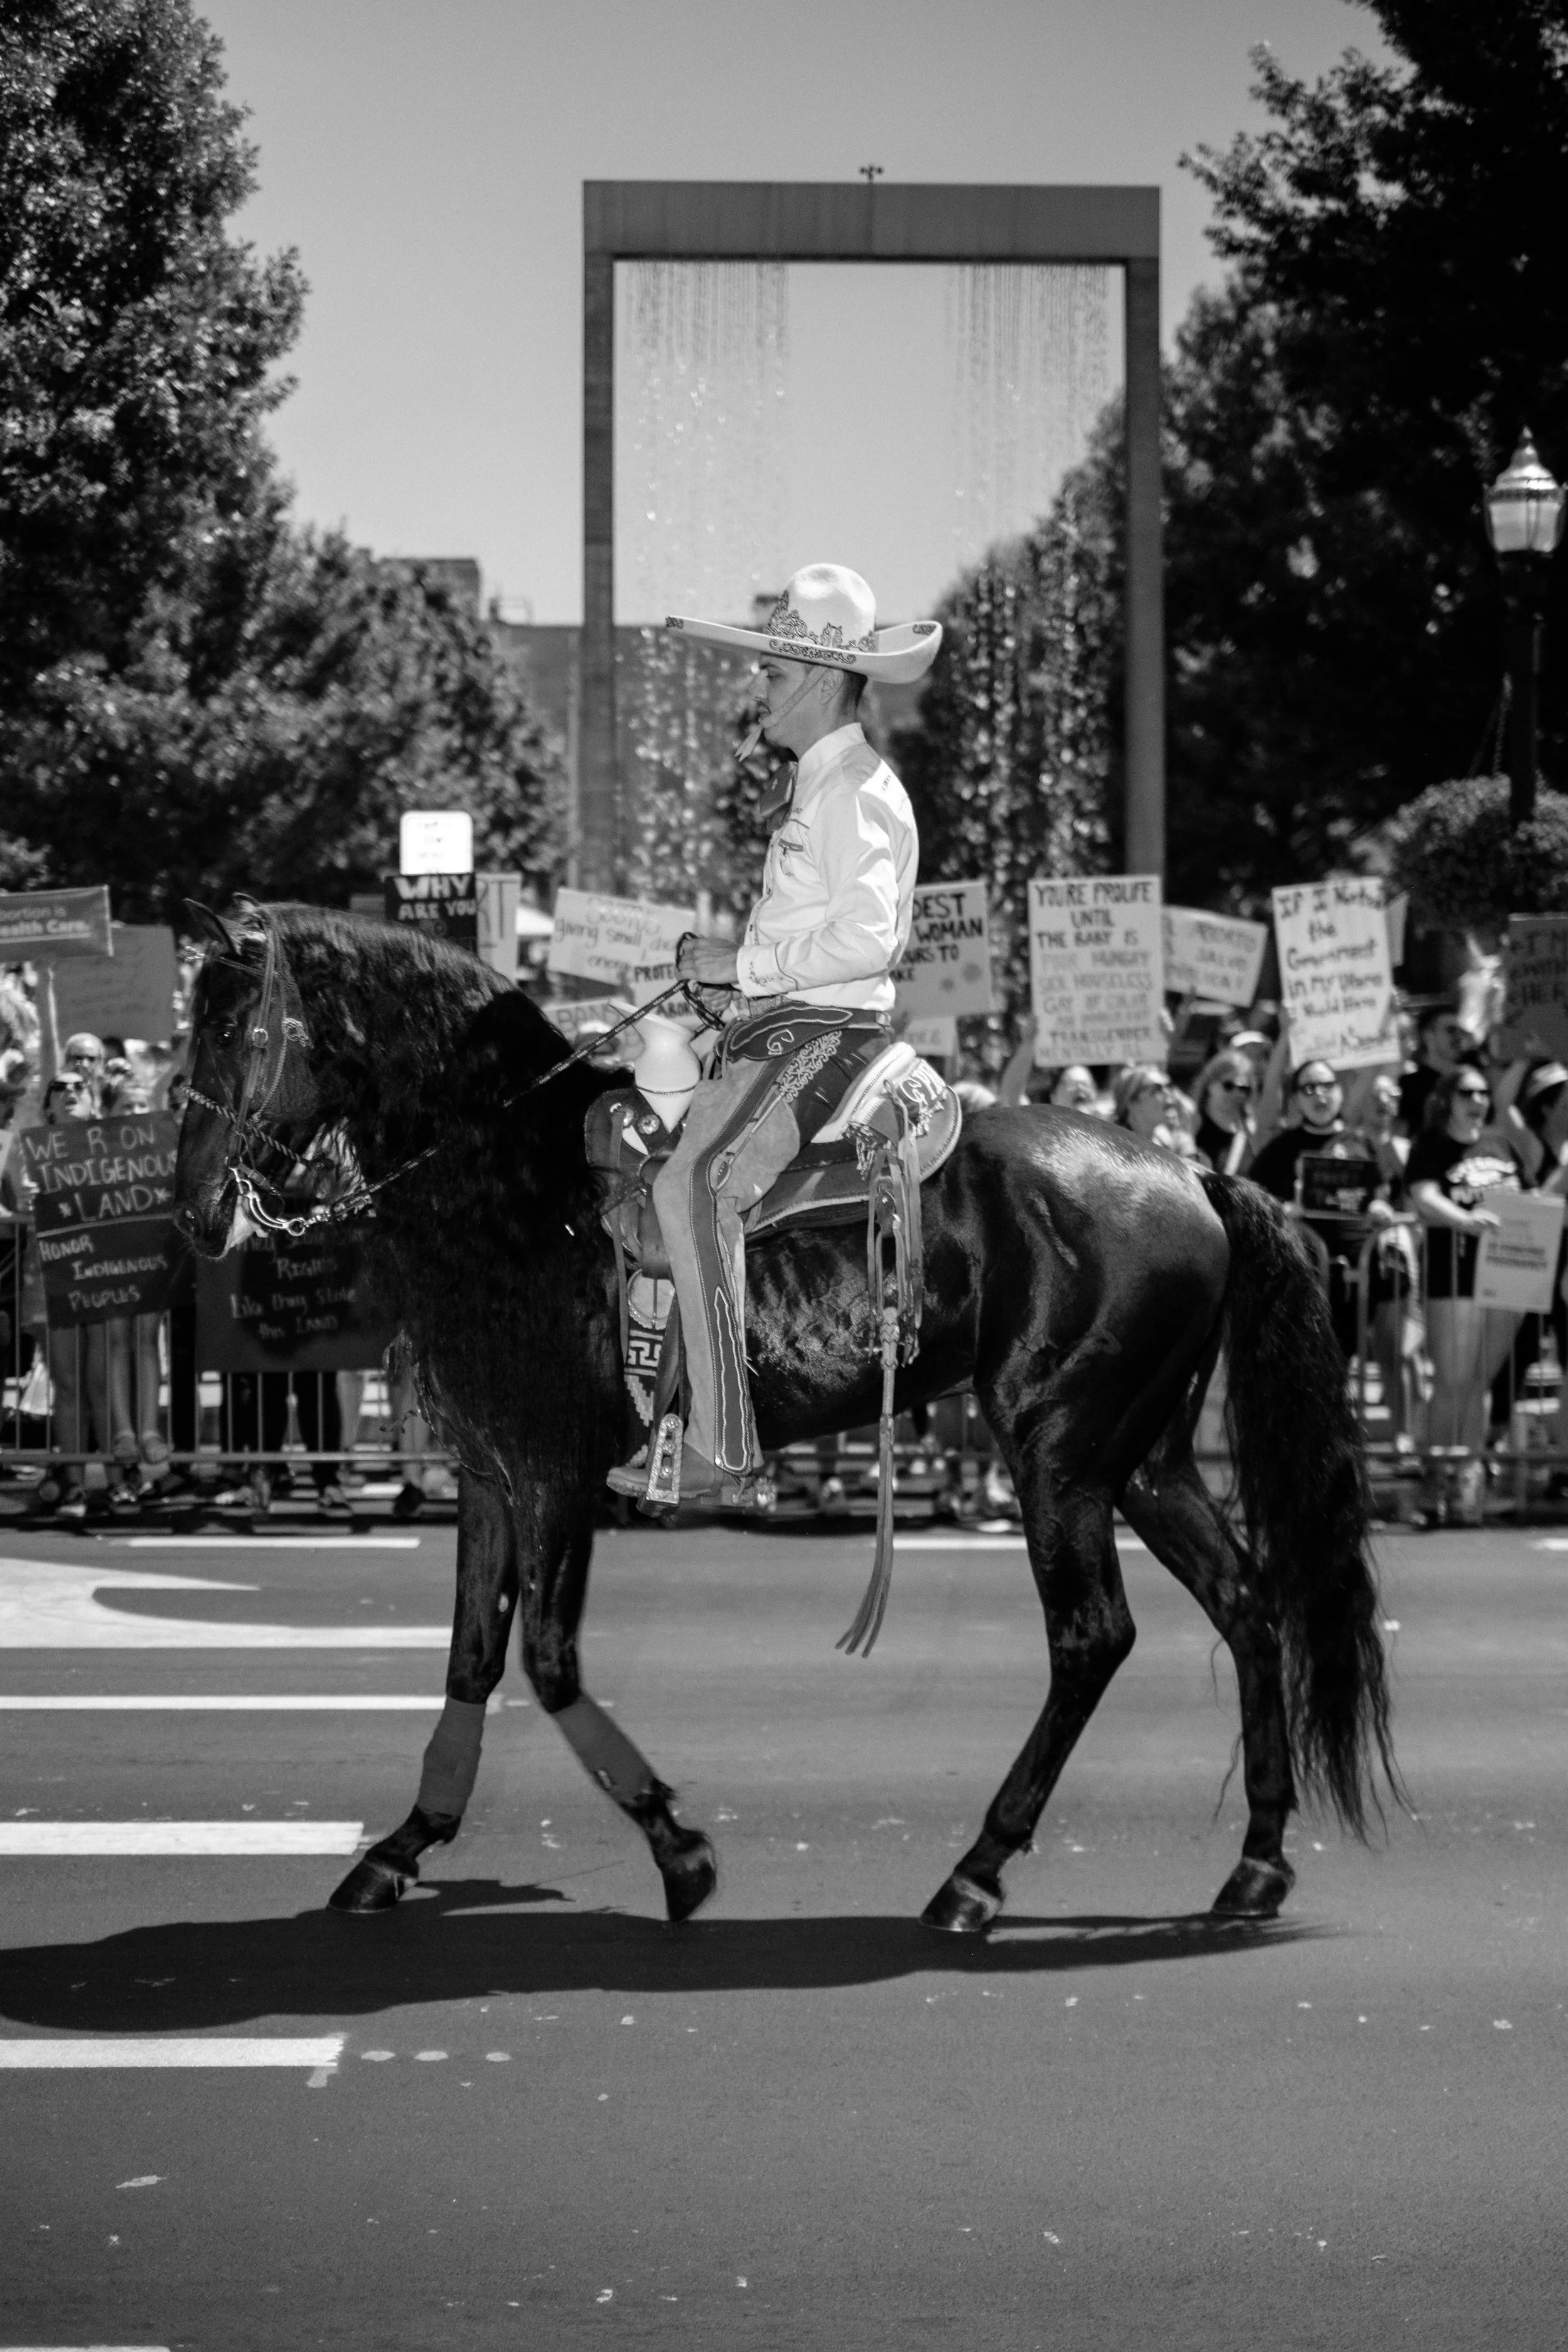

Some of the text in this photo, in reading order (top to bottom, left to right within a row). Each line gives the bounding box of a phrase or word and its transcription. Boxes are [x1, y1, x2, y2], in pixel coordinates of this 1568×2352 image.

[393, 875, 470, 899] WHY
[398, 899, 477, 921] ARE YOU
[1070, 909, 1115, 928] UNTIL
[0, 920, 43, 936] ealth
[607, 928, 642, 946] small
[914, 918, 983, 942] WOMAN
[1035, 931, 1067, 948] THE
[1124, 929, 1138, 946] IS
[938, 943, 959, 963] TO
[634, 963, 675, 982] PROTE
[26, 1125, 155, 1160] WE R ON
[39, 1234, 93, 1261] HONOR
